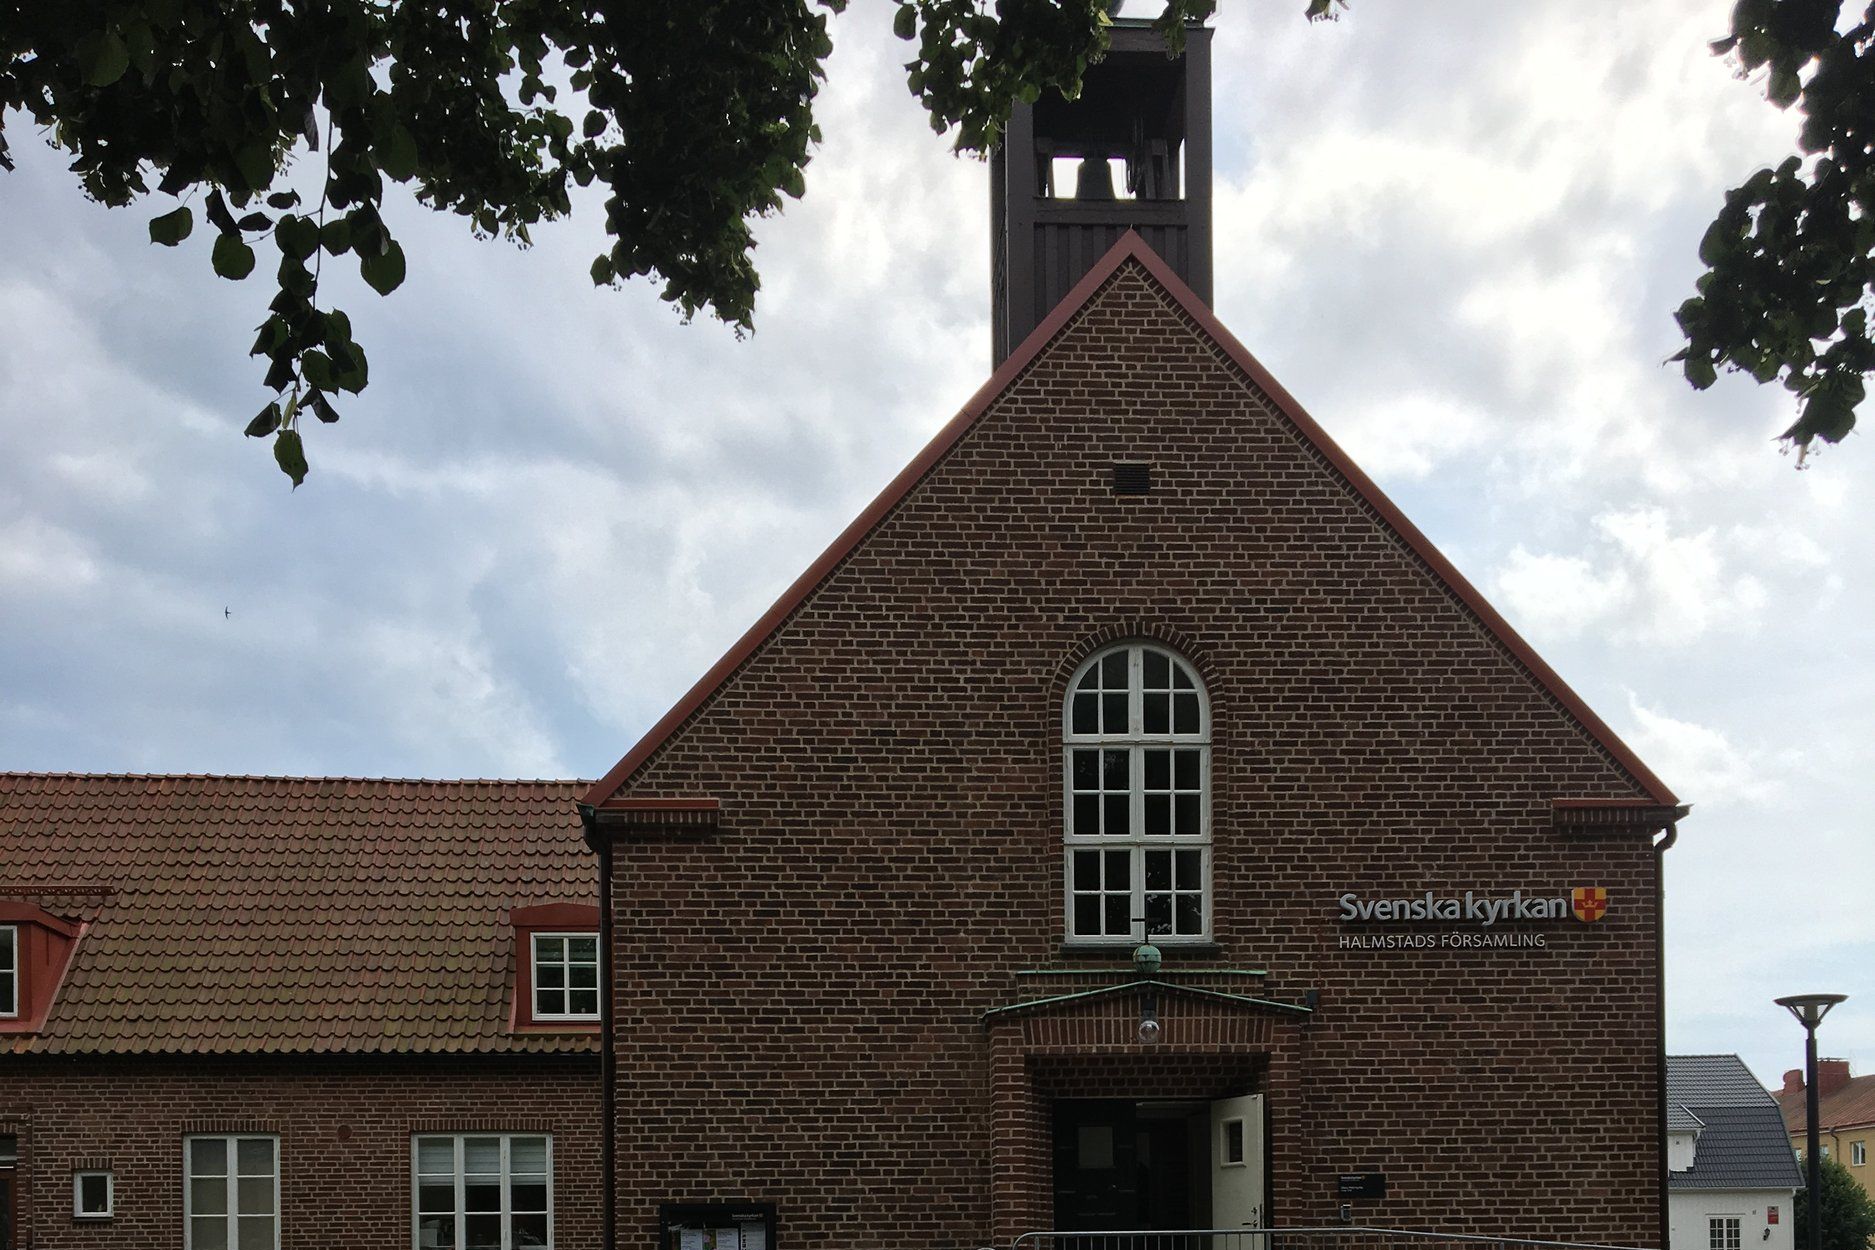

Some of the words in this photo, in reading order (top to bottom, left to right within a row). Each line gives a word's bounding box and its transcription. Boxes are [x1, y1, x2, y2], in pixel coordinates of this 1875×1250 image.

[1339, 891, 1460, 921] Svenska
[1465, 891, 1567, 926] kyrkan
[1339, 935, 1436, 949] HALMSTADS
[1441, 931, 1545, 949] FÖRSAMLING
